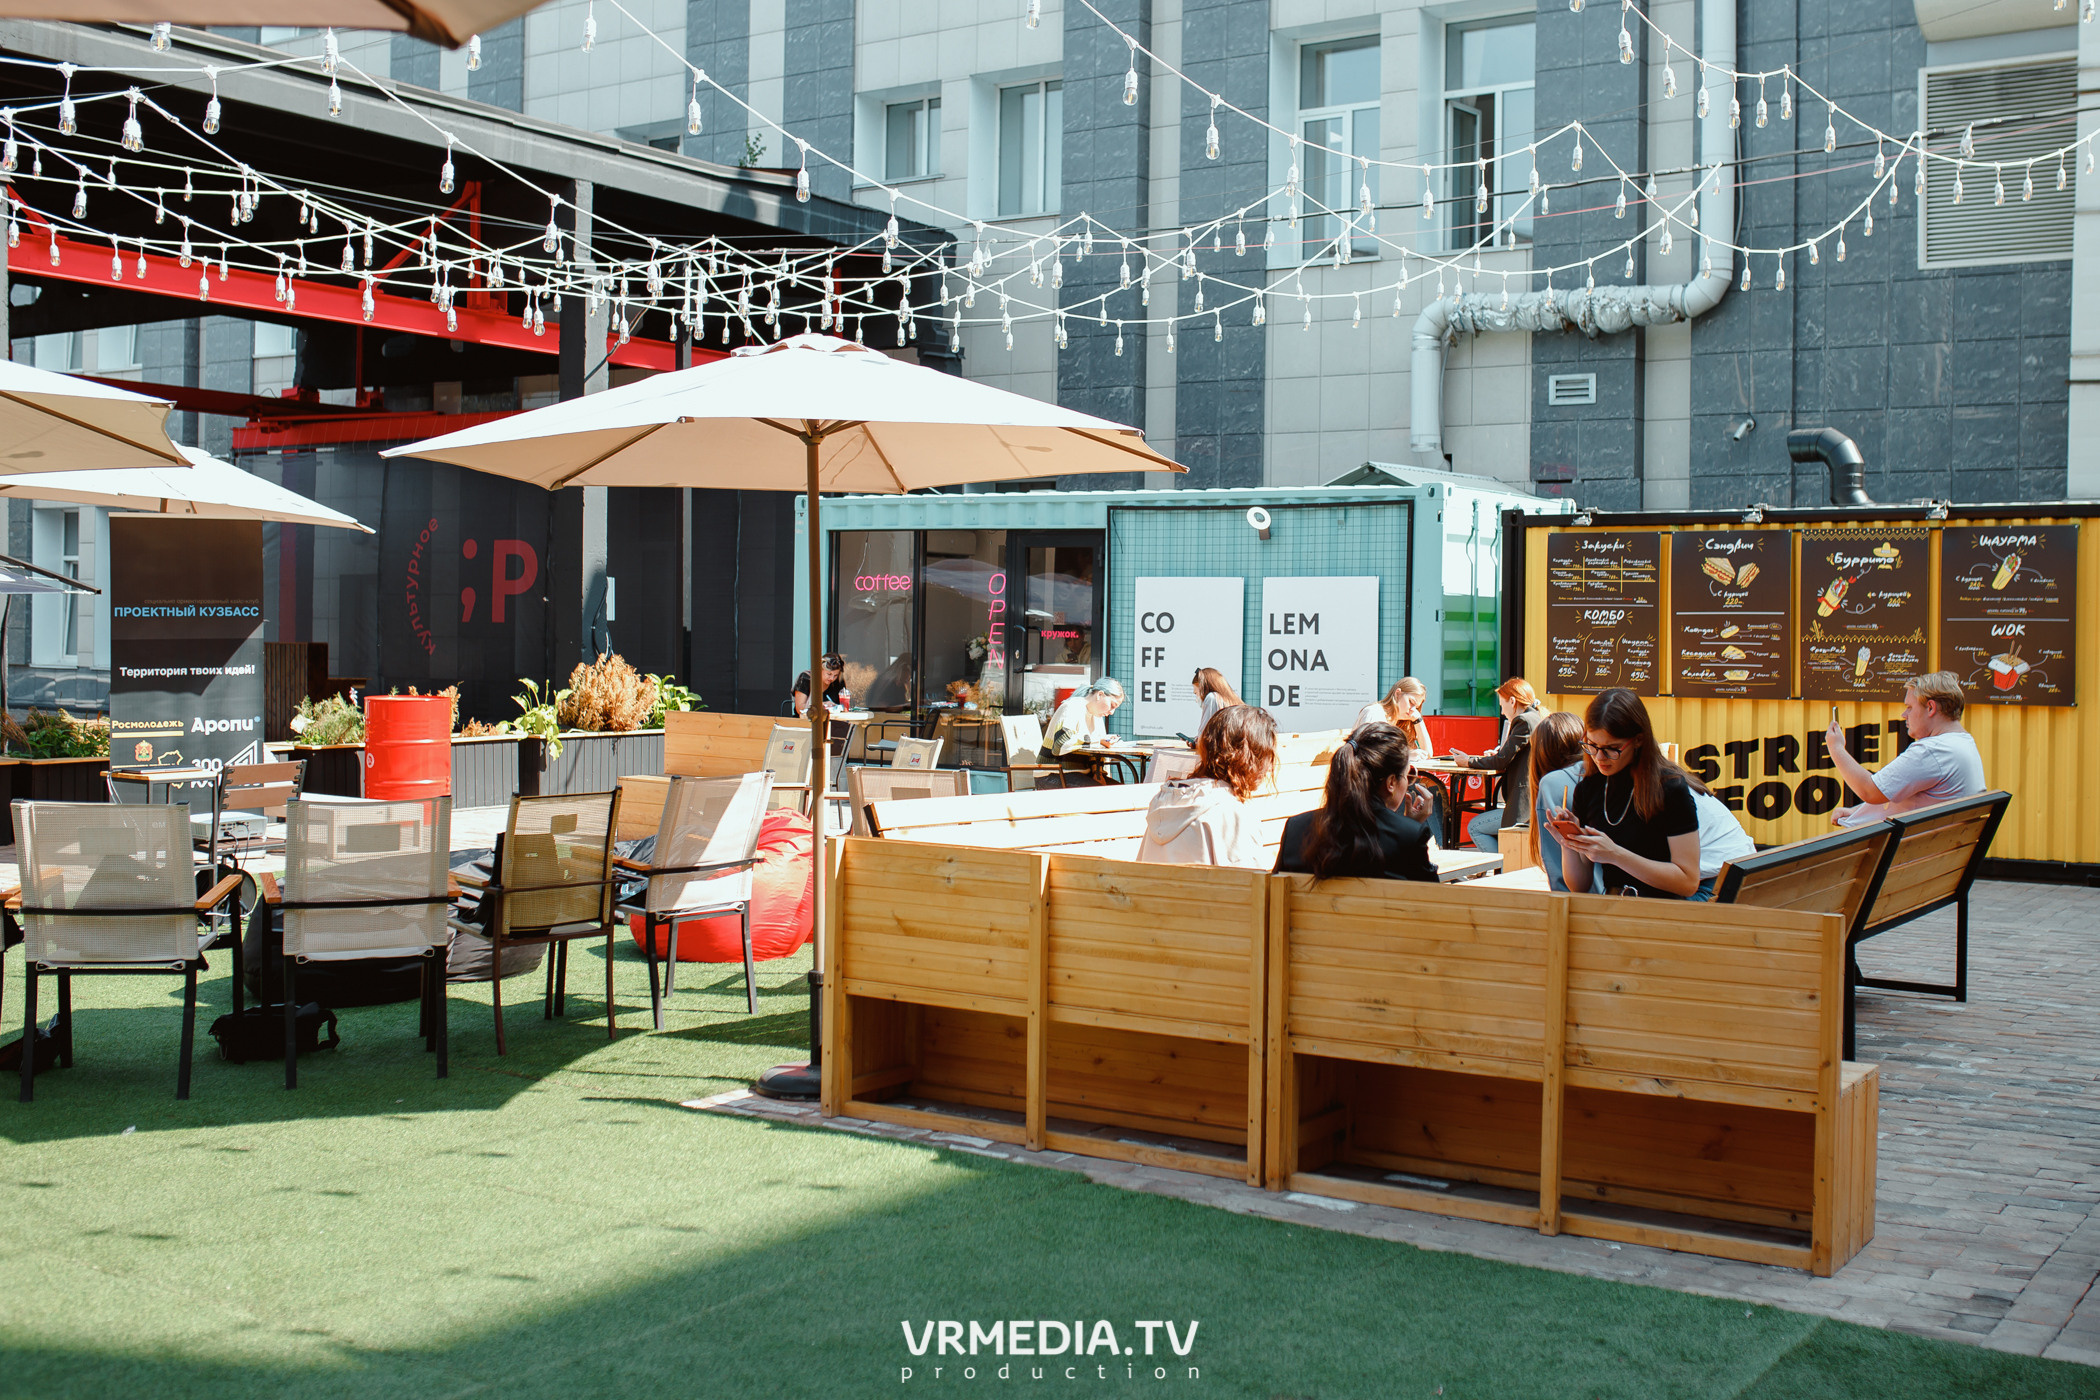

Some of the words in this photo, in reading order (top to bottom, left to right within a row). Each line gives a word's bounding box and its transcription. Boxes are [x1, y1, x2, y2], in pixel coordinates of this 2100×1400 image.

[1582, 539, 1625, 553] Закуски
[1705, 538, 1754, 554] Сэндвич
[1980, 534, 2038, 547] ШАУРМА
[1834, 552, 1894, 569] Буррито
[406, 518, 438, 656] культурное
[855, 574, 910, 591] coffee
[114, 605, 196, 618] ПРОЕКТНЫЙ
[200, 606, 260, 617] КУЗБАСС
[1584, 610, 1625, 620] КОМБО
[988, 573, 1006, 670] OPEN
[1141, 612, 1174, 634] CO
[1269, 613, 1320, 634] LEM
[1591, 618, 1618, 626] наборы
[1991, 624, 2026, 636] WOK
[1041, 630, 1079, 639] кружок.
[1142, 647, 1166, 668] FF
[1268, 648, 1330, 671] ONA
[120, 666, 188, 678] Территория
[190, 668, 222, 676] твоих
[225, 664, 256, 676] идей!
[1141, 681, 1166, 702] EE
[1268, 684, 1300, 707] DE
[1713, 769, 1876, 821] FOO
